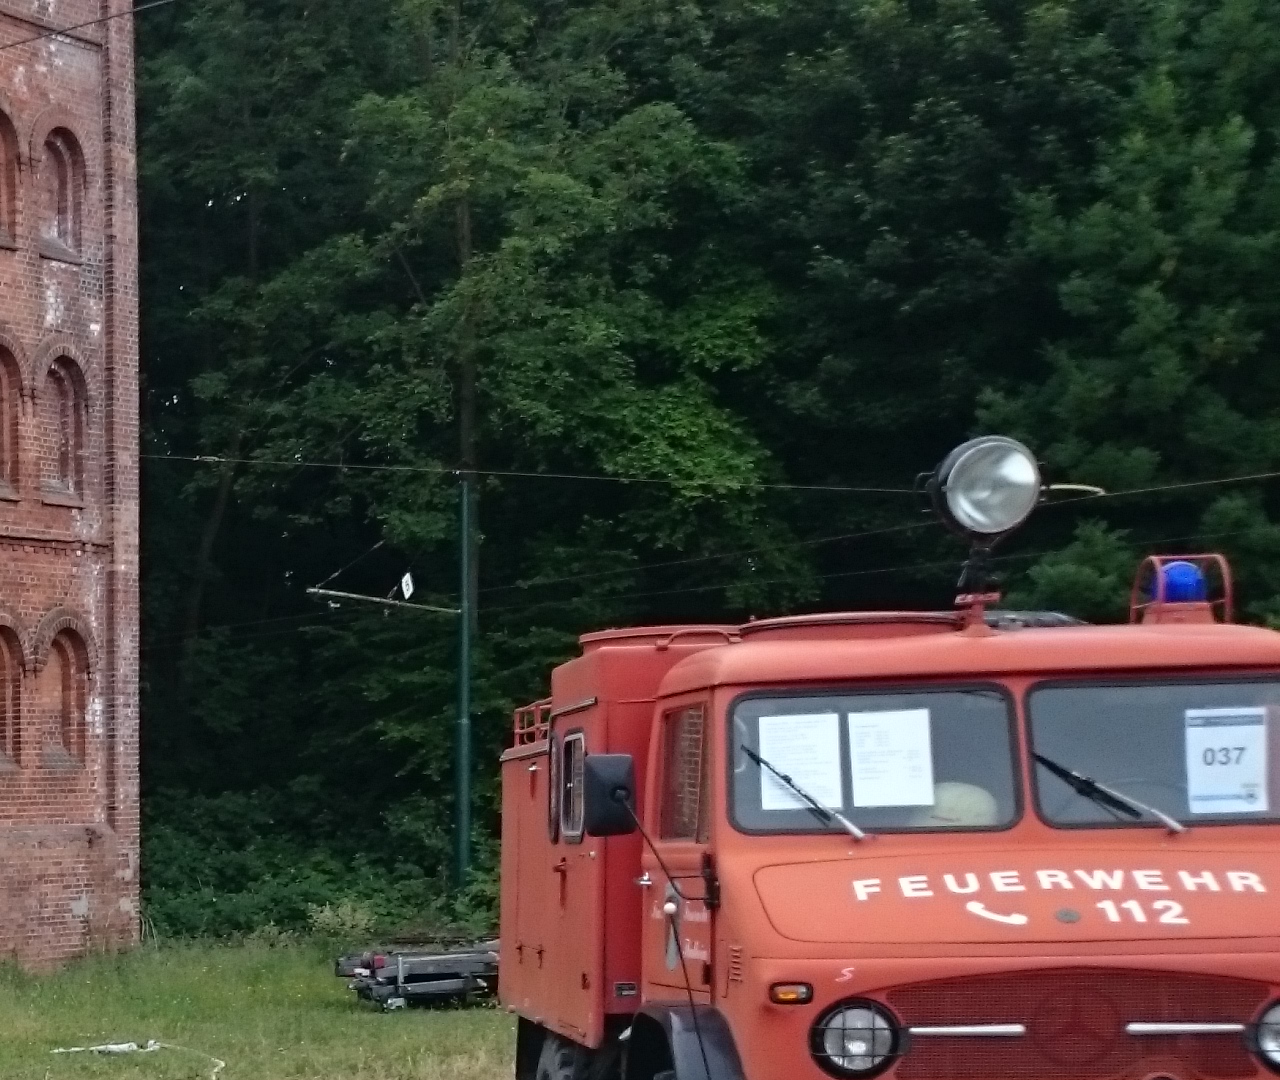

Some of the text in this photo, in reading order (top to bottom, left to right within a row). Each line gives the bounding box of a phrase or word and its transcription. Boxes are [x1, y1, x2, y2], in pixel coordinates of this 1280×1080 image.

[1202, 747, 1245, 766] 037
[852, 868, 1268, 900] FEUERWEHR
[1095, 900, 1191, 924] 112
